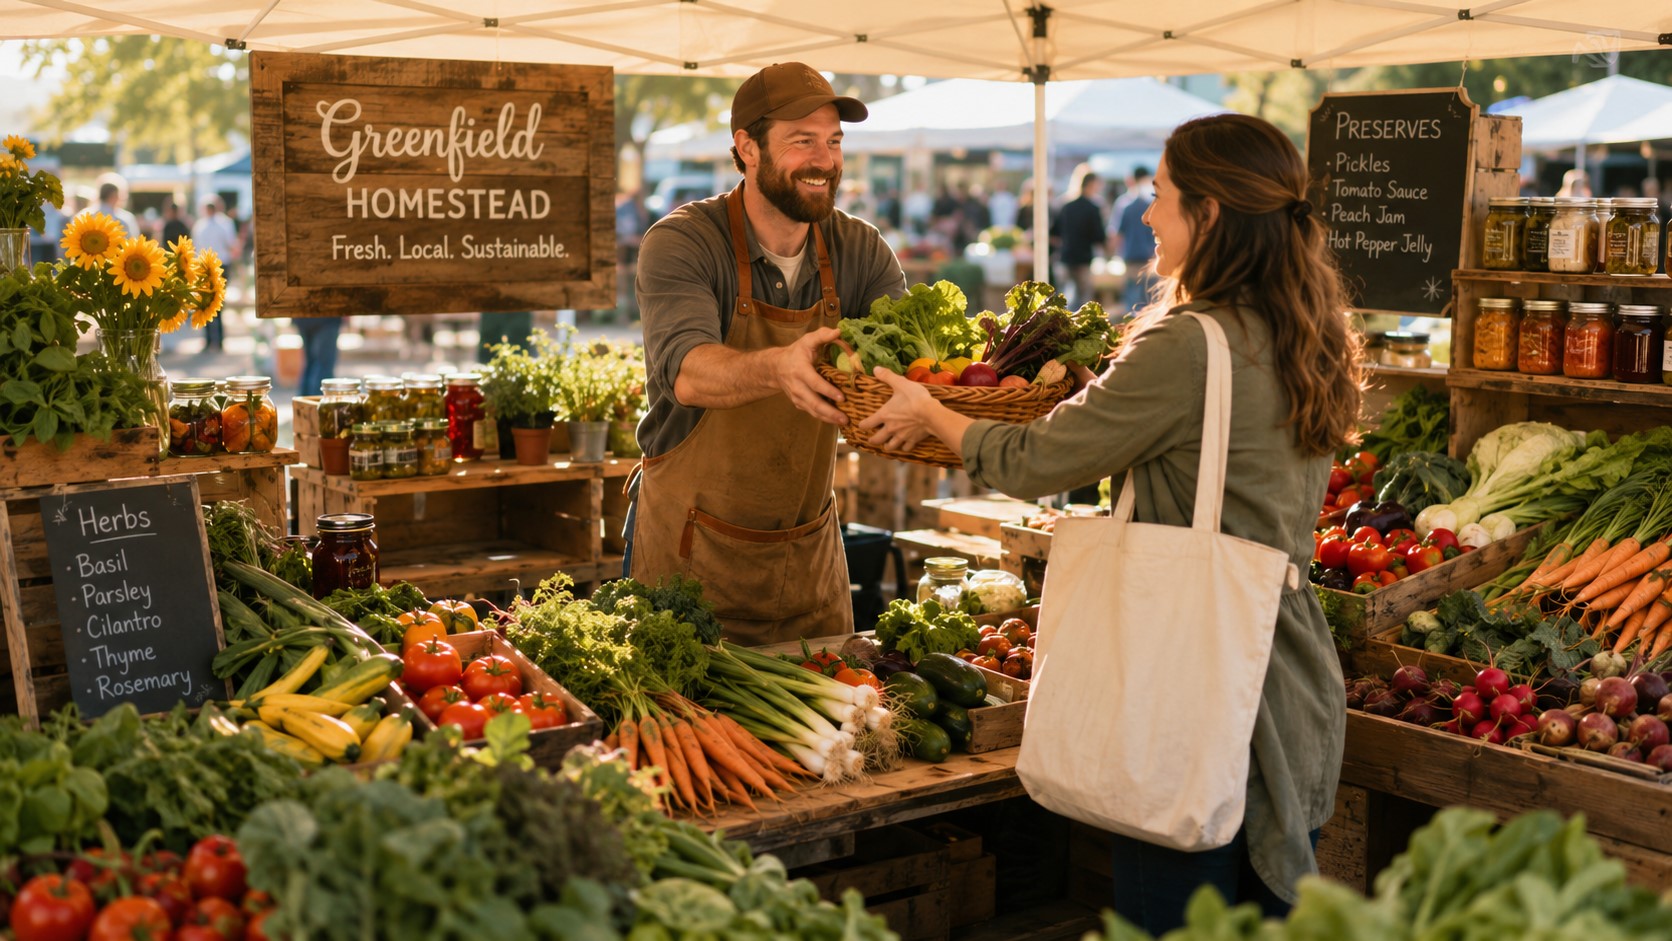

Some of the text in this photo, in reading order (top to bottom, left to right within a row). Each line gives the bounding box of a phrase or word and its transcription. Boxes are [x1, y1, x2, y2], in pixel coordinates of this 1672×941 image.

[1336, 111, 1441, 140] PRESERVES
[316, 98, 544, 183] Greenfield
[1335, 151, 1390, 173] Pickles
[346, 187, 551, 220] HOMESTEAD
[1332, 178, 1428, 200] Tomato Sauce
[1331, 203, 1405, 224] Peach Jam
[331, 234, 569, 261] Fresh. Local. Sustainable.
[1328, 229, 1433, 263] Hot Pepper Jelly
[78, 503, 151, 536] Herbs
[76, 548, 128, 577] Basil
[81, 579, 152, 609] Parsley
[86, 611, 162, 639] Cilantro
[88, 644, 157, 675] Thyme
[95, 670, 192, 700] Rosemary
